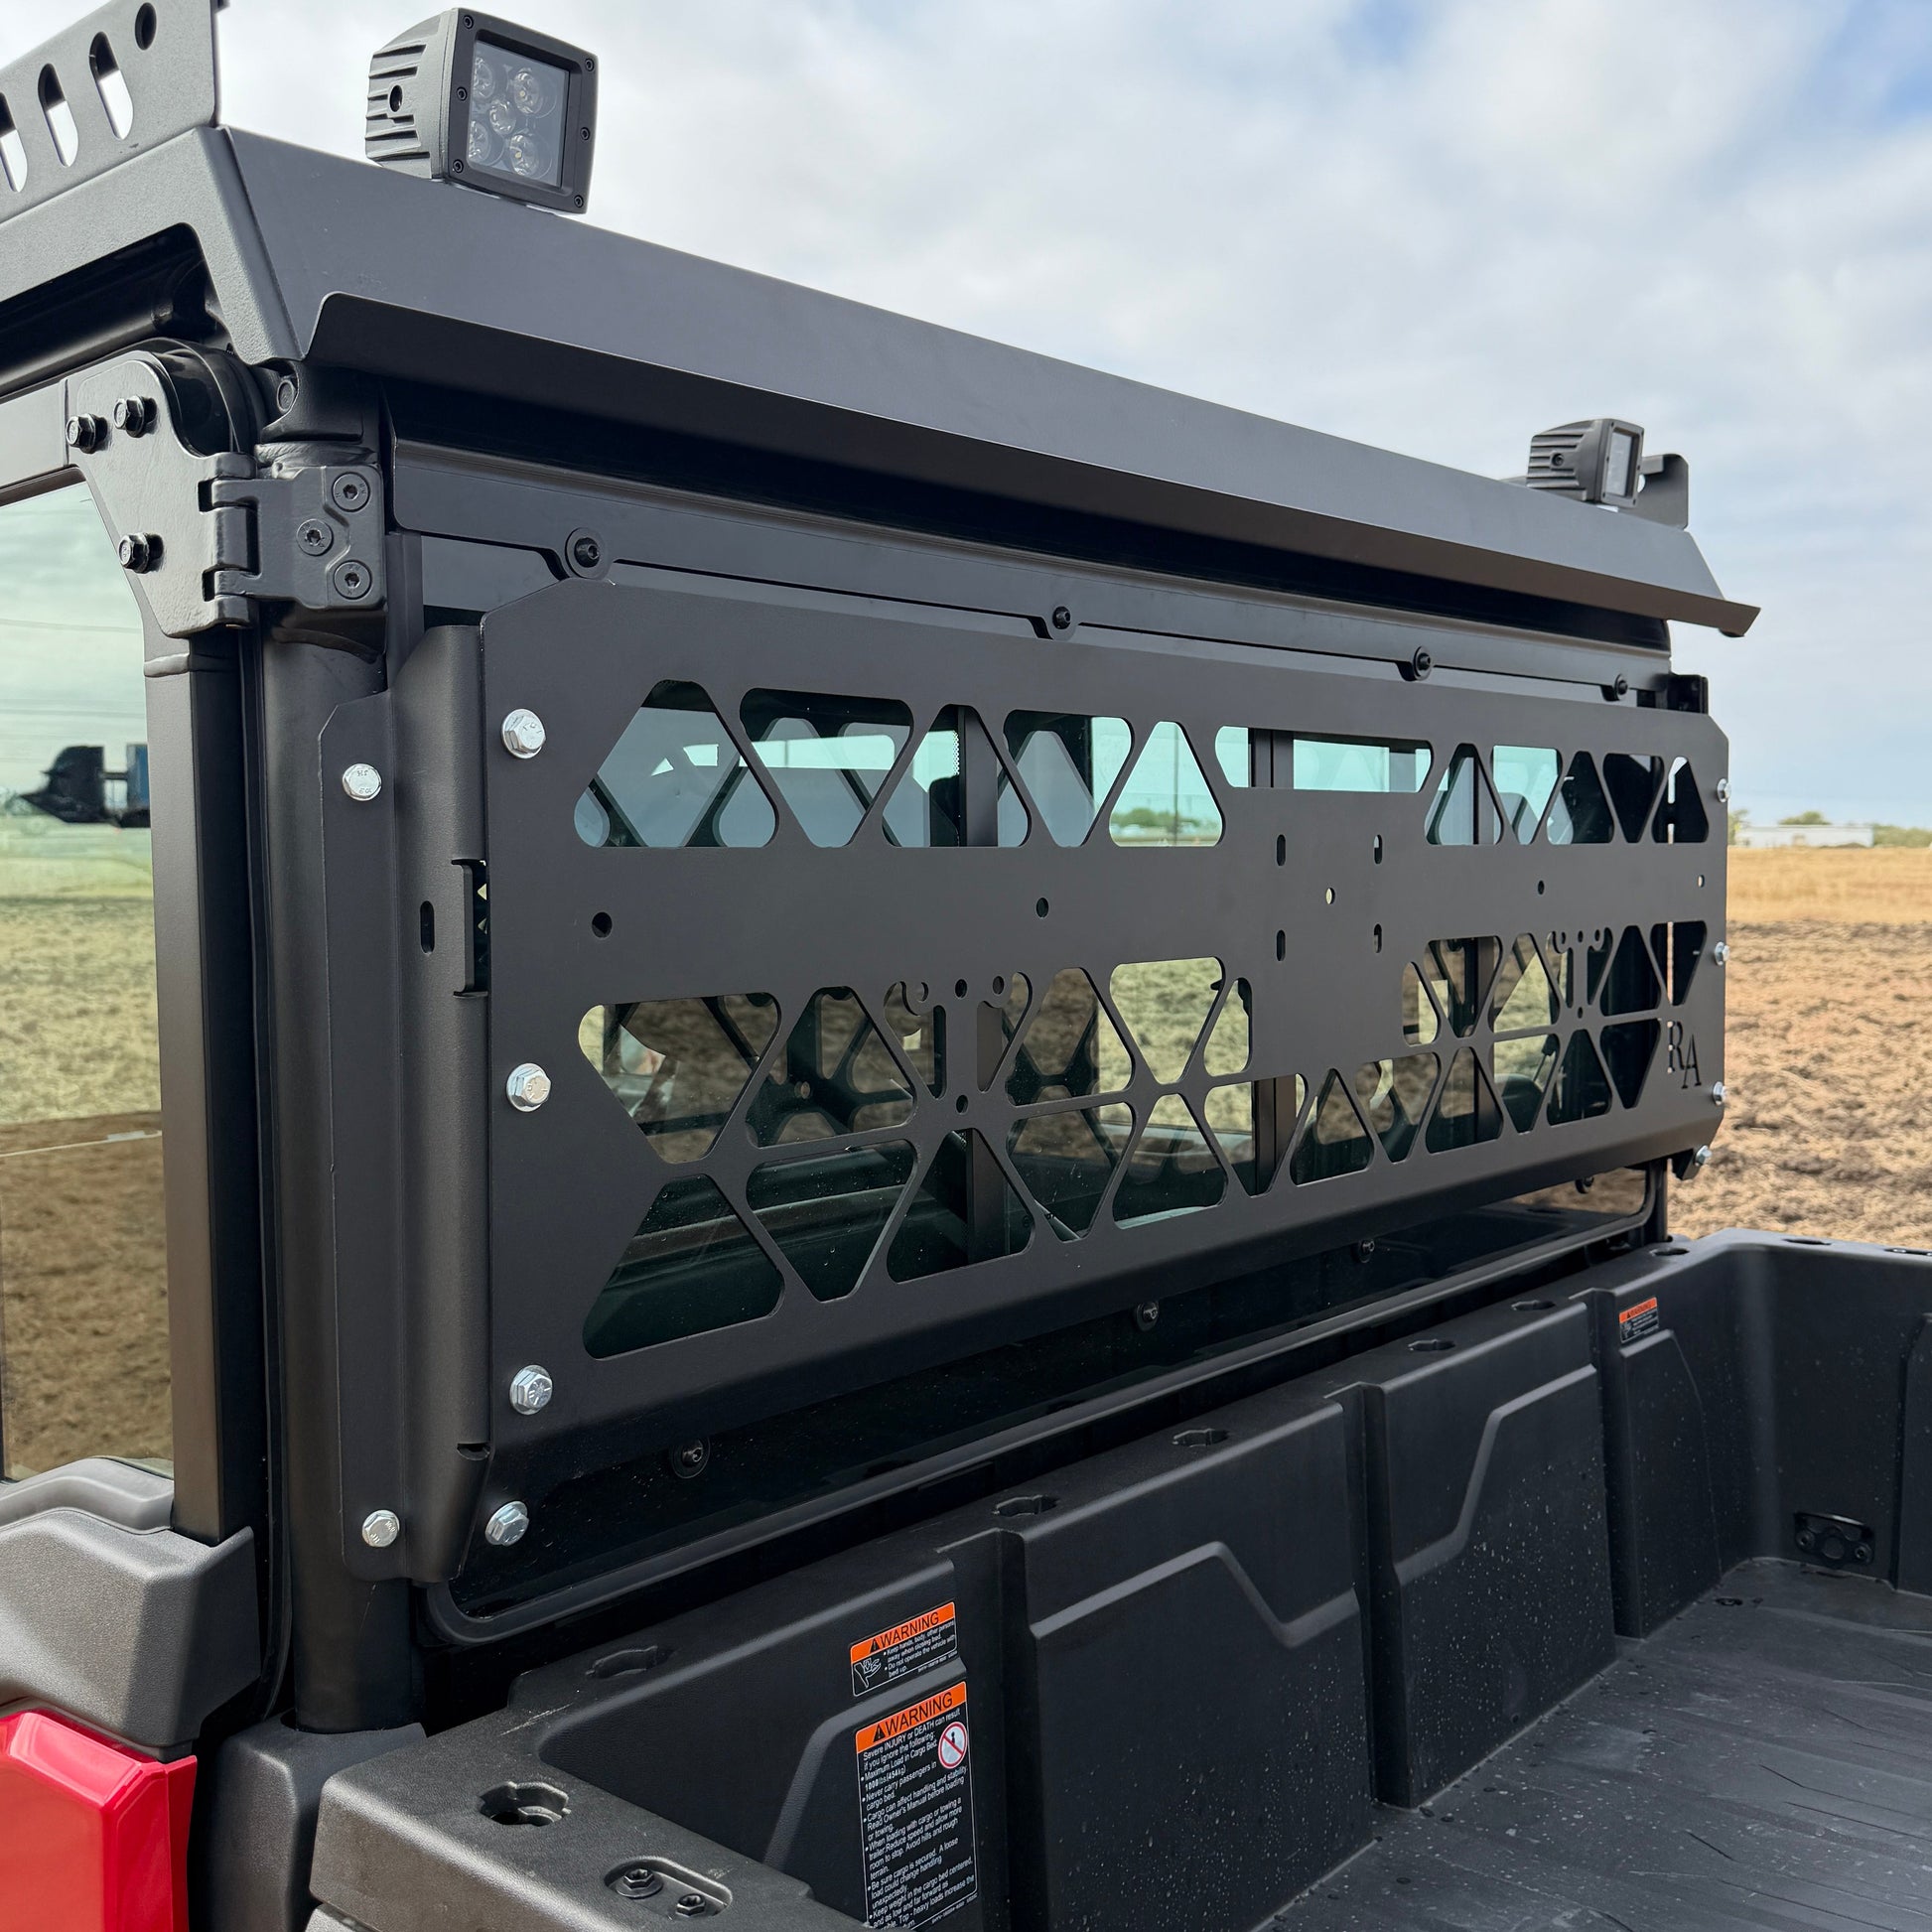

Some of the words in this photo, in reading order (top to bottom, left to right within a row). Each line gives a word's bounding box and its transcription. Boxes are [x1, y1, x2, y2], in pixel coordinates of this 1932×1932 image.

[880, 1611, 939, 1648] WARNING
[887, 1646, 898, 1655] Keep
[904, 1650, 922, 1663] operate
[930, 1639, 946, 1650] vehicle
[889, 1668, 898, 1678] bed
[885, 1692, 952, 1737] WARNING
[863, 1746, 883, 1761] Severe
[885, 1733, 905, 1751] INJURY
[914, 1720, 934, 1736] DEATH
[935, 1717, 945, 1726] can
[945, 1708, 960, 1721] result
[864, 1762, 868, 1771] if
[869, 1758, 880, 1770] you
[881, 1749, 898, 1763] ignore
[899, 1744, 908, 1753] the
[865, 1762, 890, 1781] Maximum
[891, 1755, 903, 1768] Load
[910, 1746, 926, 1758] Cargo
[866, 1788, 883, 1802] Never
[884, 1781, 897, 1793] carry
[899, 1764, 930, 1787] passengers
[867, 1808, 885, 1822] Cargo
[886, 1802, 896, 1812] can
[897, 1793, 912, 1807] affect
[912, 1782, 935, 1799] handling
[936, 1774, 946, 1786] and
[867, 1798, 883, 1811] cargo
[884, 1790, 896, 1802] bed.
[867, 1816, 883, 1832] Read
[884, 1806, 905, 1823] Owner's
[906, 1794, 926, 1811] Manual
[927, 1786, 944, 1800] before
[945, 1776, 964, 1791] loading
[868, 1833, 874, 1842] or
[875, 1823, 895, 1838] towing.
[869, 1838, 886, 1852] When
[886, 1827, 905, 1843] loading
[906, 1820, 917, 1831] with
[918, 1812, 933, 1825] cargo
[933, 1808, 939, 1817] or
[940, 1799, 957, 1814] towing
[907, 1826, 923, 1841] speed
[924, 1819, 934, 1831] and
[935, 1813, 948, 1826] allow
[949, 1806, 962, 1818] more
[870, 1858, 884, 1870] room
[892, 1848, 904, 1860] stop.
[905, 1837, 920, 1852] Avoid
[921, 1832, 932, 1843] hills
[932, 1825, 942, 1836] and
[943, 1817, 958, 1831] rough
[870, 1865, 890, 1880] terrain.
[871, 1881, 880, 1890] Be
[881, 1874, 893, 1885] sure
[894, 1865, 908, 1880] cargo
[915, 1848, 937, 1866] secured.
[944, 1838, 958, 1850] loose
[872, 1886, 884, 1899] load
[885, 1877, 898, 1892] could
[899, 1868, 919, 1884] change
[920, 1856, 942, 1872] handling
[873, 1905, 888, 1919] Keep
[889, 1892, 906, 1910] weight
[922, 1877, 937, 1890] cargo
[938, 1868, 948, 1881] bed
[873, 1916, 884, 1929] and
[885, 1913, 892, 1922] as
[893, 1905, 902, 1917] low
[902, 1899, 912, 1911] and
[921, 1883, 941, 1900] forward
[942, 1880, 948, 1889] as
[930, 1892, 943, 1905] loads
